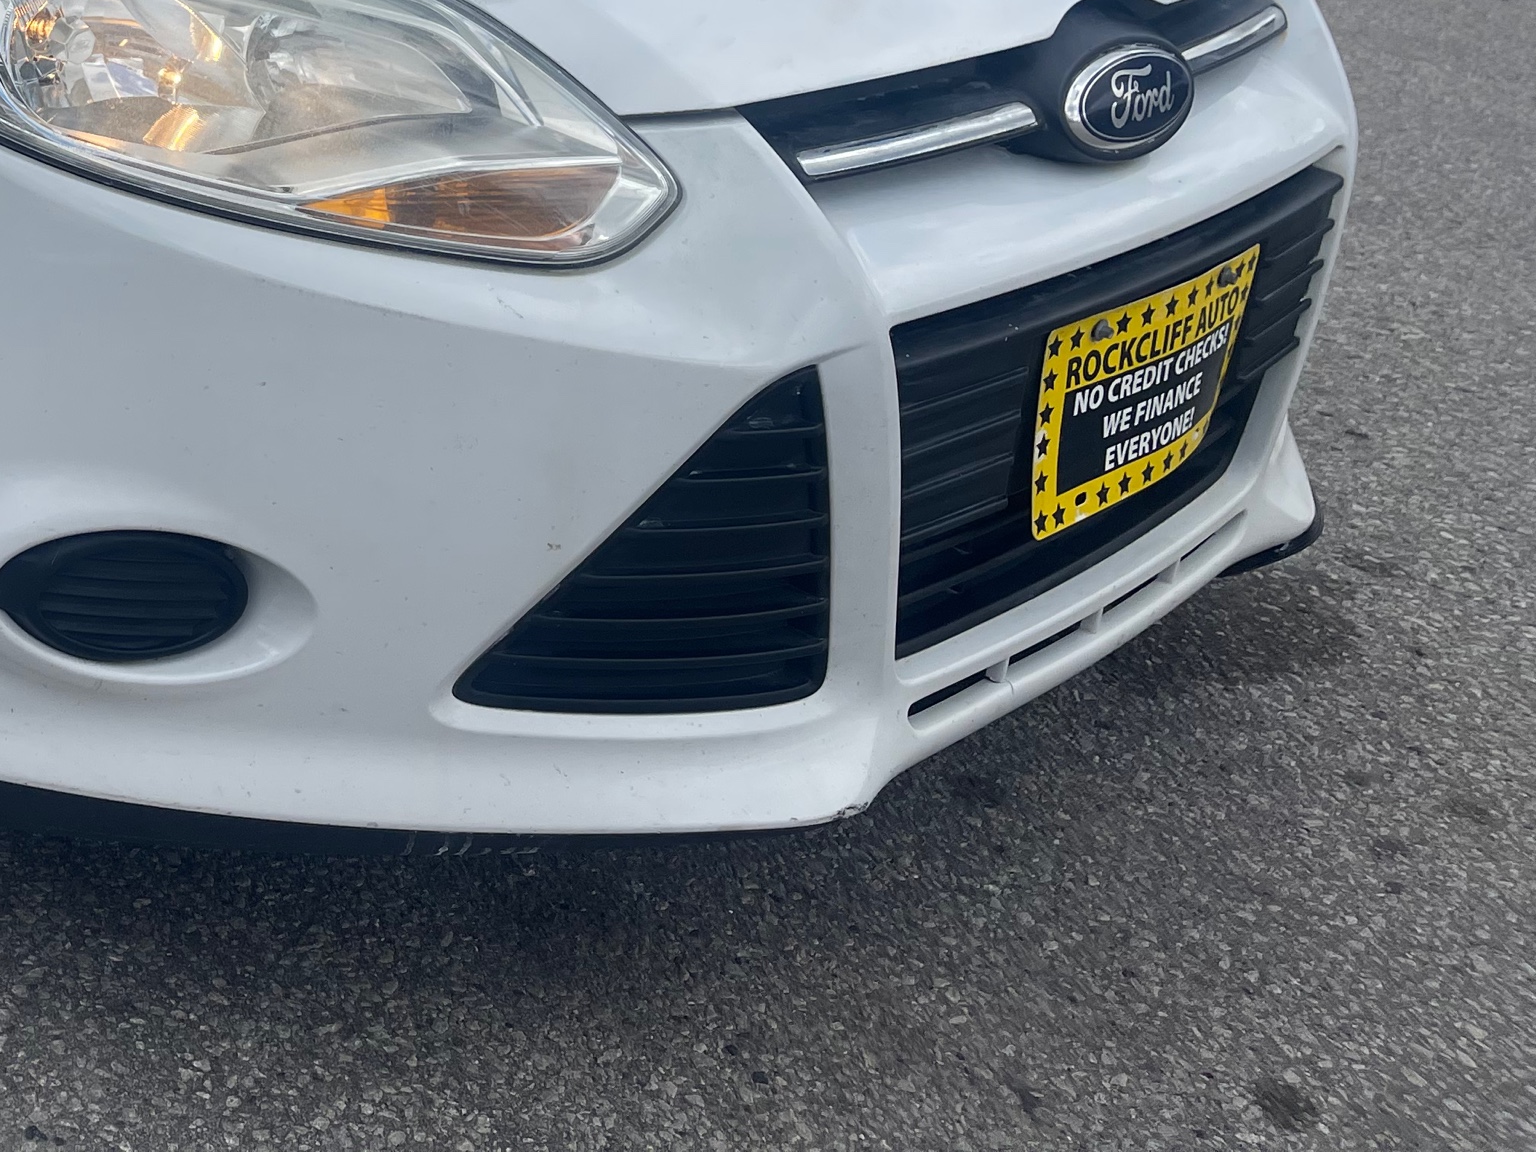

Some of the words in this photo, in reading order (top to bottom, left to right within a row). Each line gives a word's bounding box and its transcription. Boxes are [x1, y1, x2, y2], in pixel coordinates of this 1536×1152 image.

[1111, 63, 1175, 129] Ford
[1066, 313, 1195, 389] ROCKCLIFF
[1196, 286, 1240, 334] AUTO
[1072, 385, 1105, 416] NO
[1108, 357, 1174, 403] CREDIT
[1174, 322, 1230, 375] CHECKS!
[1102, 409, 1132, 438] WE
[1134, 371, 1203, 426] FINANCE
[1104, 406, 1196, 471] EVERYONE!
